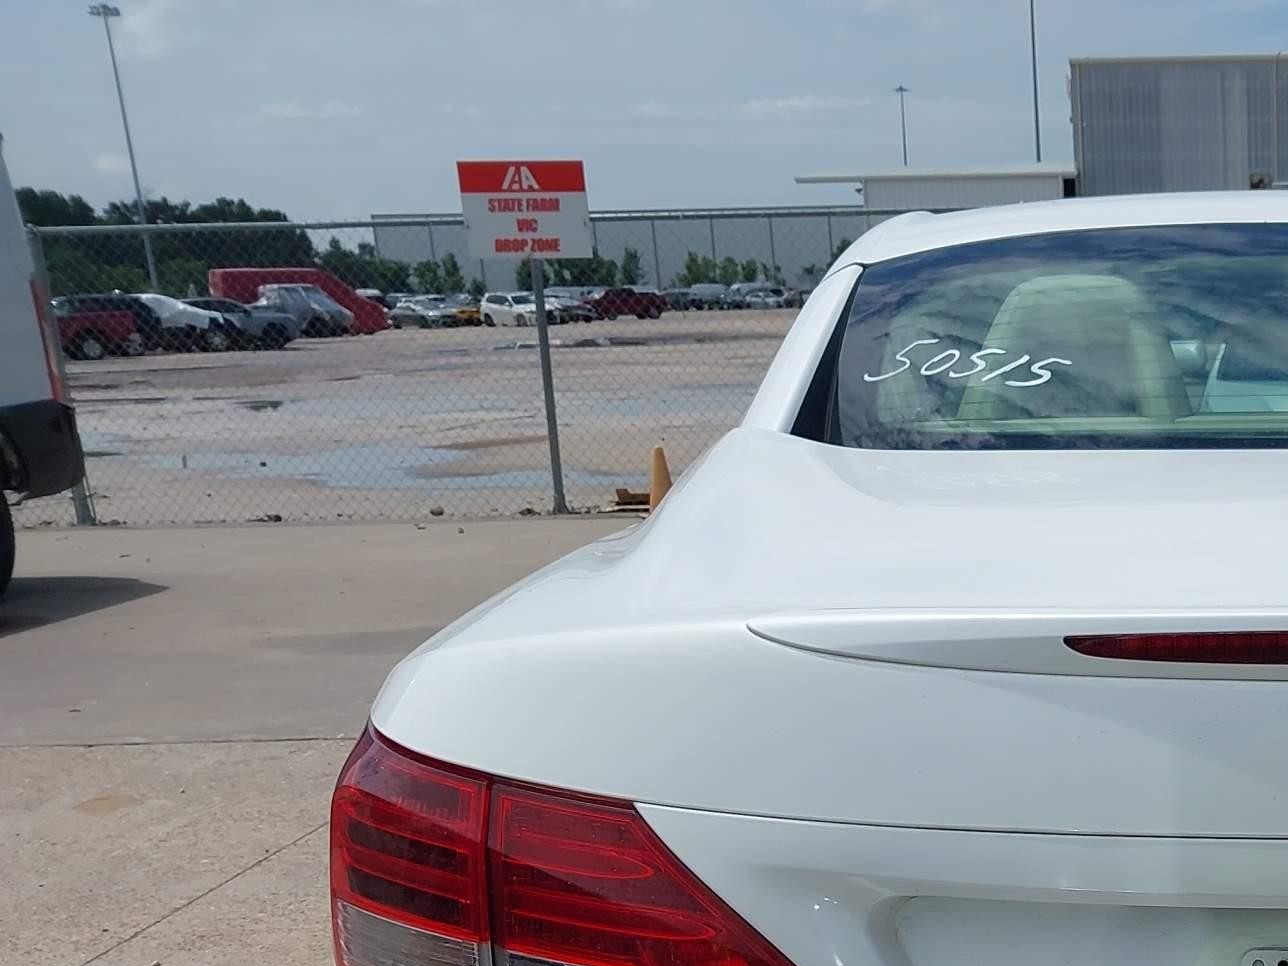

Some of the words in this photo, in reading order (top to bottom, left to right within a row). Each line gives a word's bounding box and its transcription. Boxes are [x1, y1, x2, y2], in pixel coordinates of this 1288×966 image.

[488, 198, 523, 212] STATE
[526, 198, 560, 212] FARM
[516, 218, 538, 232] VIC
[495, 238, 528, 252] DROP
[530, 238, 560, 252] ZONE
[863, 339, 1072, 386] 50515
